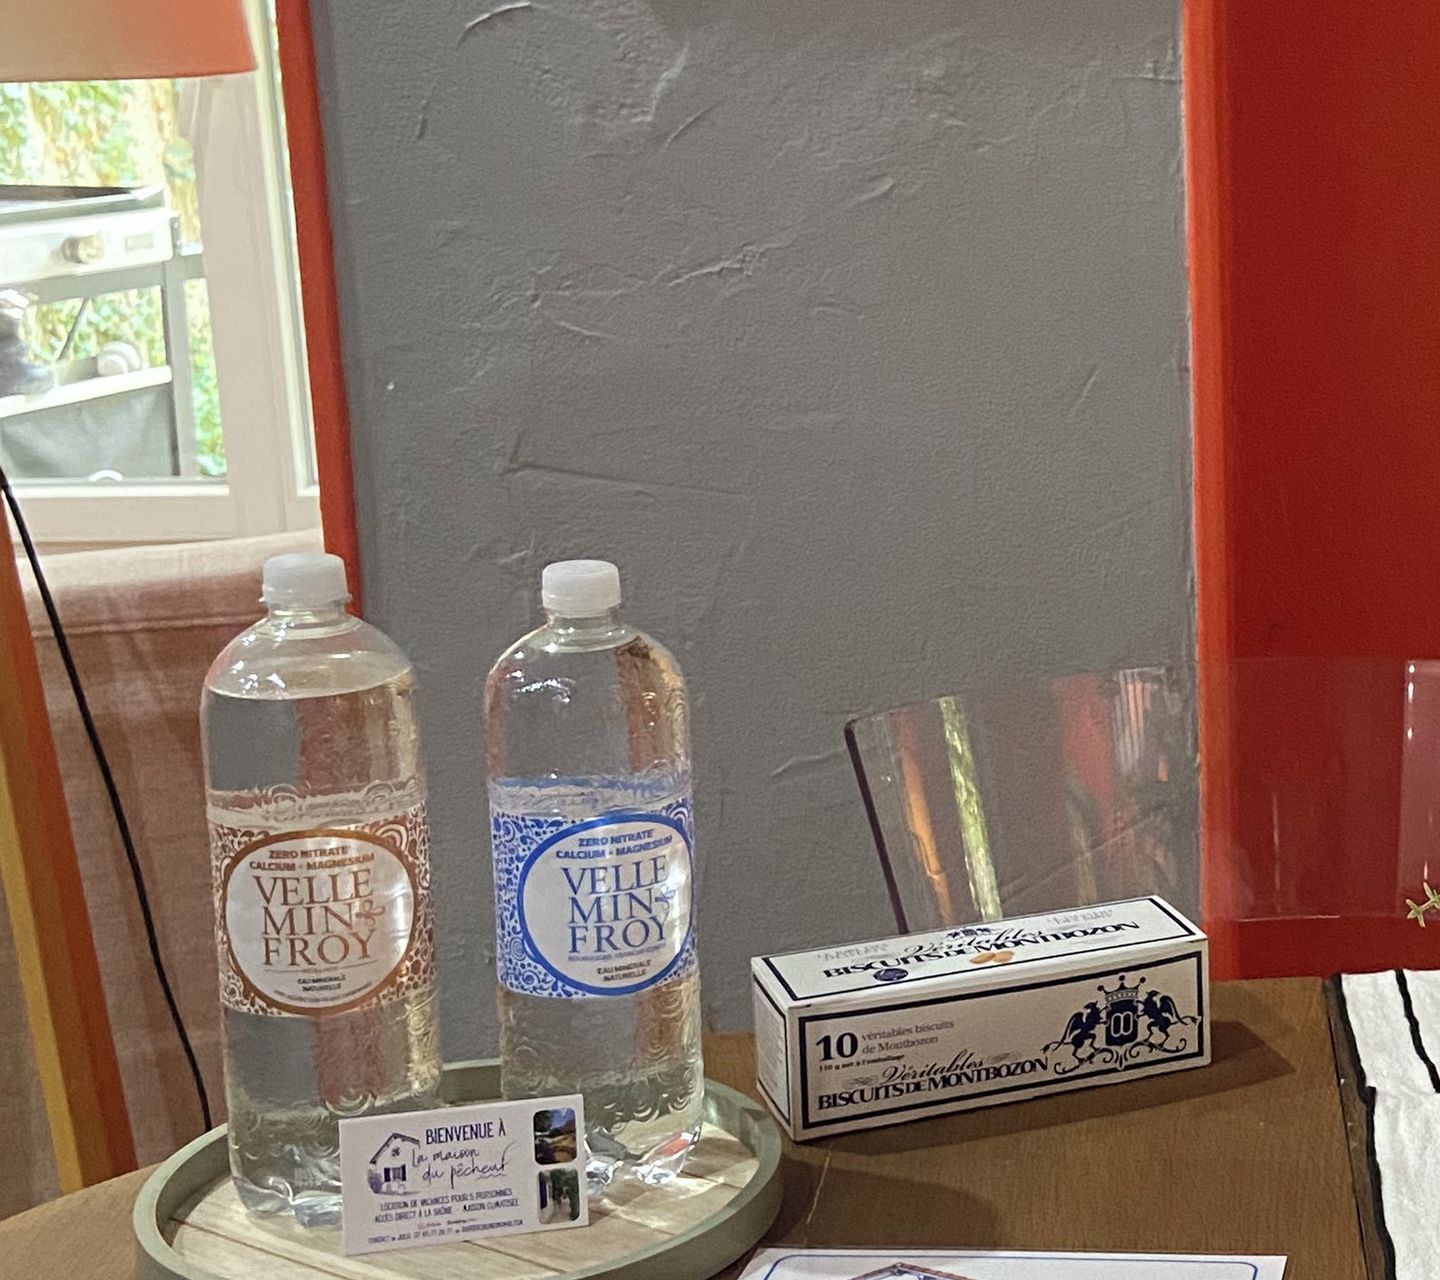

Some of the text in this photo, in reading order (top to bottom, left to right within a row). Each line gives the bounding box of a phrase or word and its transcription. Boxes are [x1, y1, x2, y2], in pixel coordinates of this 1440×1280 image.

[579, 829, 655, 846] ZERO NITRATE
[253, 869, 373, 905] VELLE
[561, 855, 667, 895] VELLE
[263, 902, 358, 936] MIN
[569, 887, 655, 924] MIN
[263, 928, 376, 966] FROY
[569, 906, 670, 953] FROY
[816, 1032, 858, 1061] 10
[915, 1021, 954, 1034] biscuits
[863, 1035, 939, 1054] de Montbozon
[818, 1082, 904, 1110] BISCUITS
[928, 1057, 1048, 1091] MONTBOZON
[881, 1049, 983, 1084] Véritables
[426, 1122, 493, 1145] BIENVENUE
[412, 1149, 427, 1167] La
[422, 1157, 507, 1189] du pêcheur
